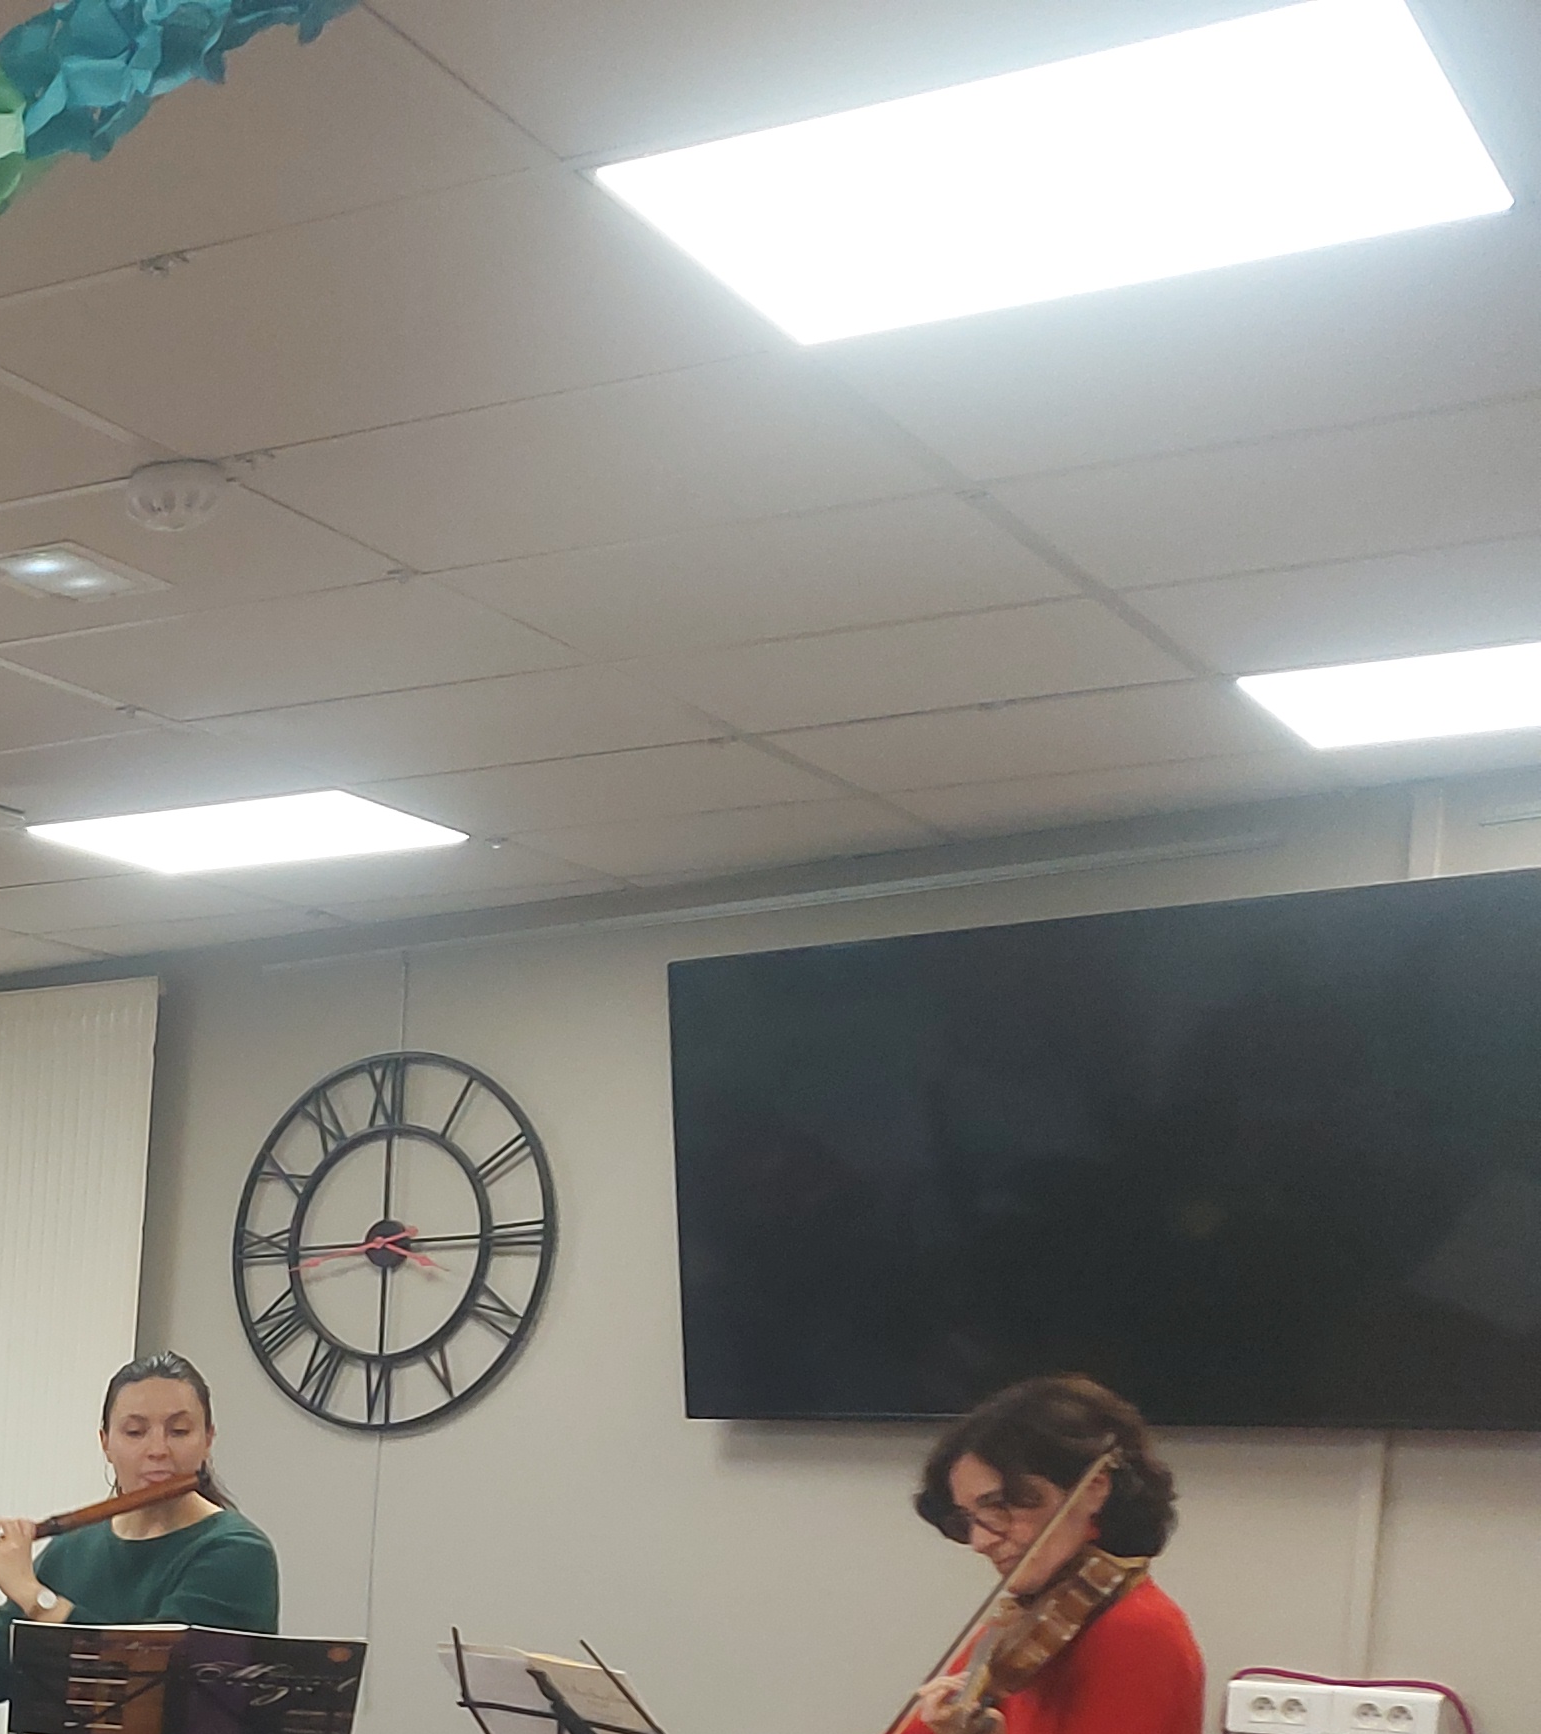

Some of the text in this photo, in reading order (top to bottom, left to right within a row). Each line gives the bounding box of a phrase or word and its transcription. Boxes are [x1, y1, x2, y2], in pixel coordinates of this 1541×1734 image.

[367, 1058, 406, 1127] XII
[299, 1089, 348, 1157] XI
[259, 1150, 313, 1198] X
[242, 1227, 291, 1259] IX
[491, 1219, 544, 1246] III
[298, 1337, 344, 1409] VII
[366, 1361, 391, 1424] VI
[424, 1345, 454, 1397] V
